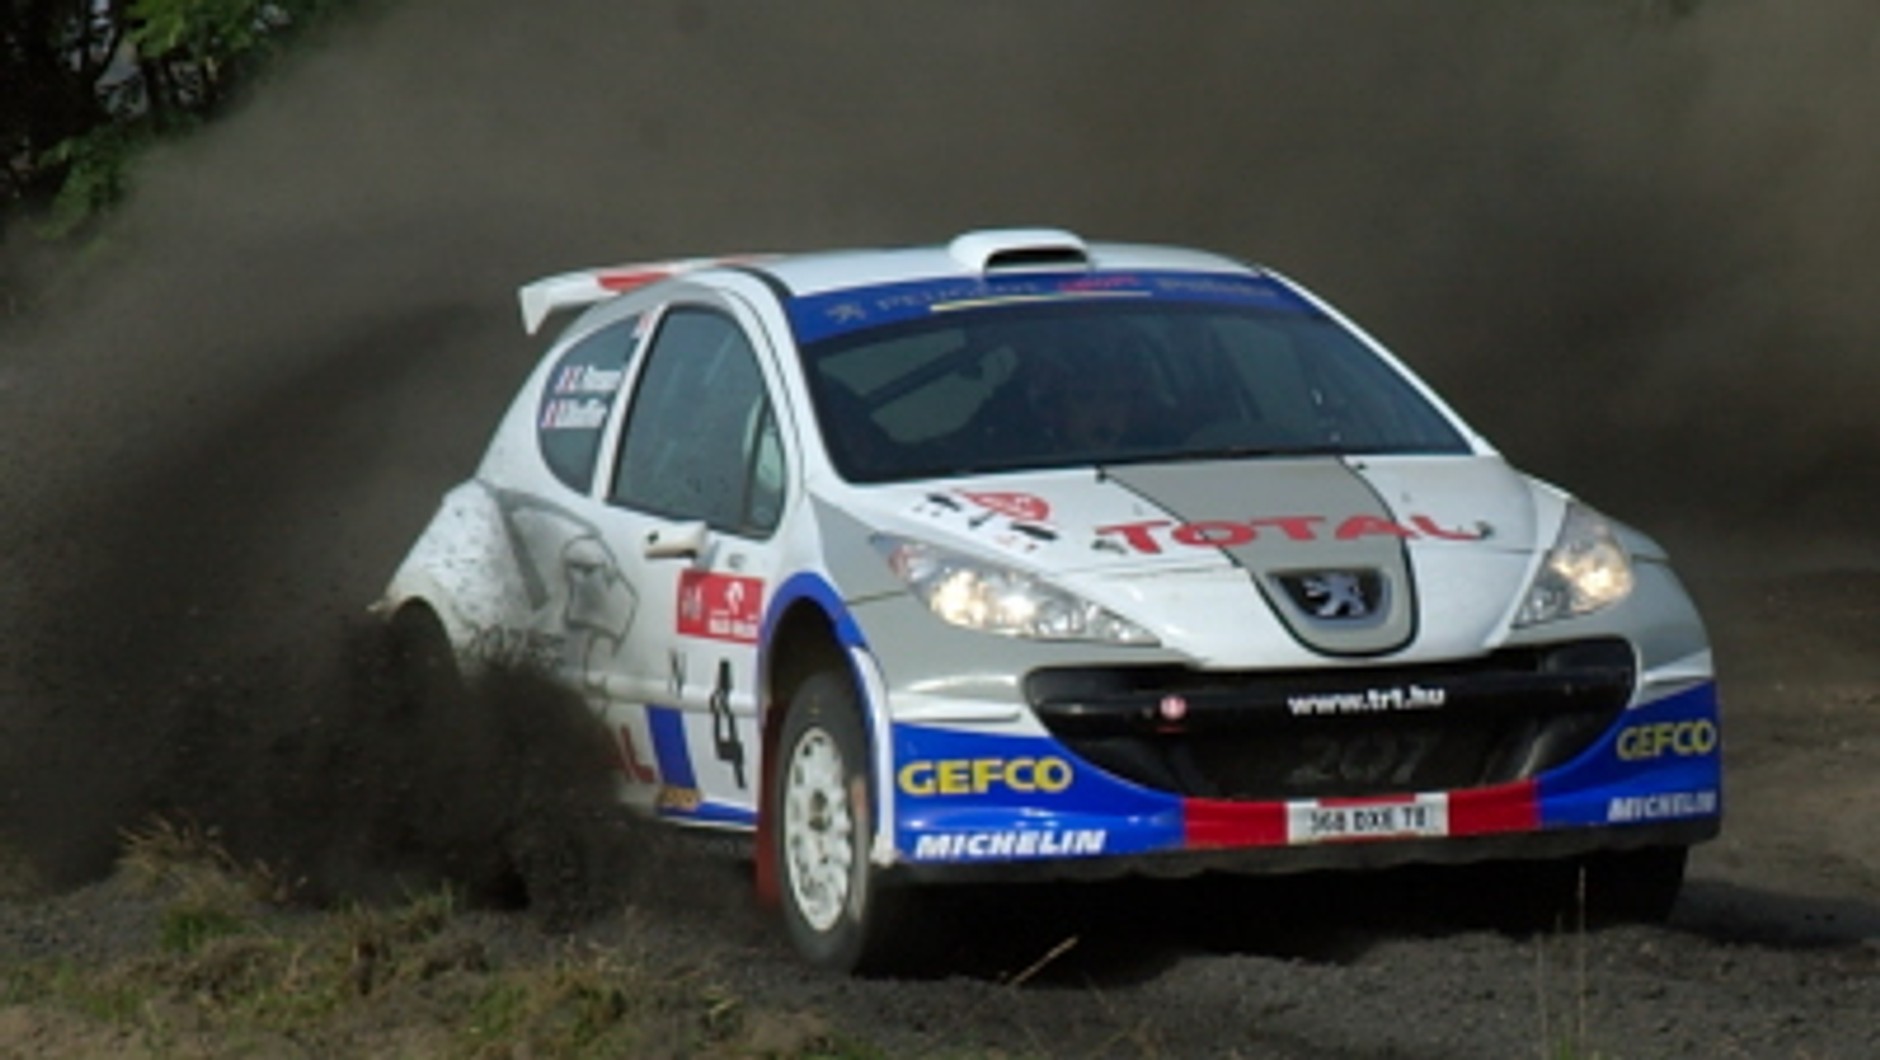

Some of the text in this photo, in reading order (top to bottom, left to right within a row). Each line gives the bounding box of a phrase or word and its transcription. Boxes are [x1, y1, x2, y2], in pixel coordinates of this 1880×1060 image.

[1094, 514, 1486, 554] TOTAL
[1287, 685, 1445, 716] www.trt.hu
[710, 658, 747, 790] 4
[1616, 718, 1717, 761] GEFCO
[898, 756, 1074, 797] GEFCO
[1607, 790, 1717, 822] MICHELIN
[915, 828, 1108, 860] MICHELIN
